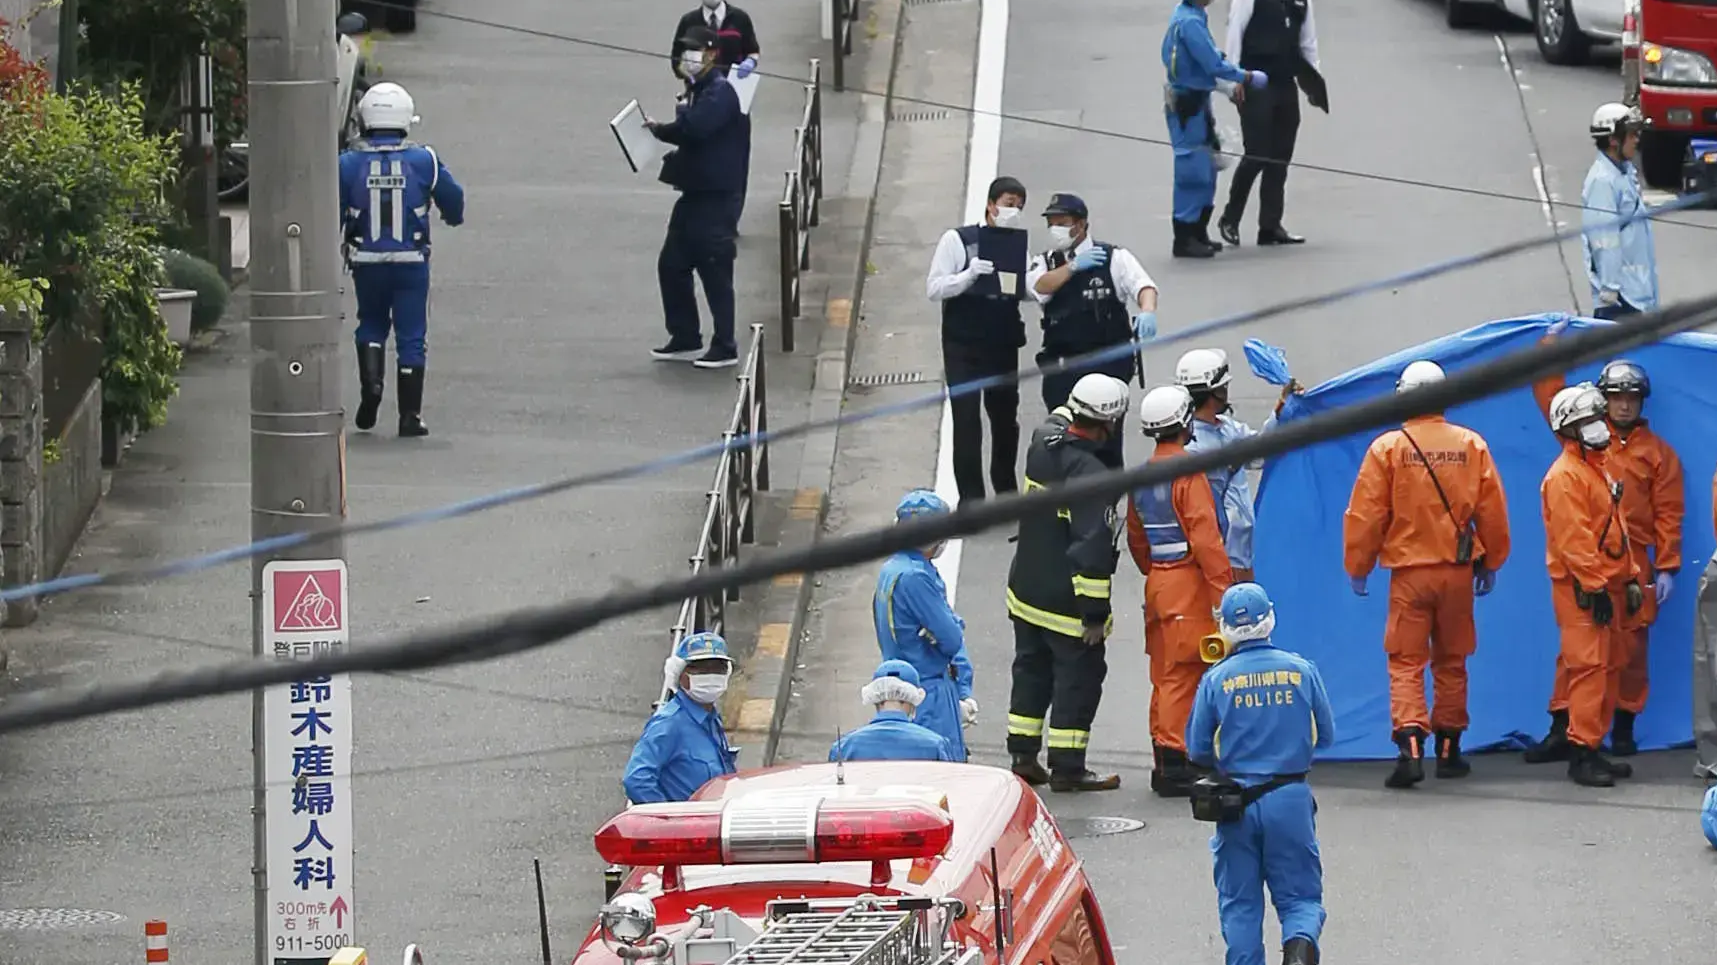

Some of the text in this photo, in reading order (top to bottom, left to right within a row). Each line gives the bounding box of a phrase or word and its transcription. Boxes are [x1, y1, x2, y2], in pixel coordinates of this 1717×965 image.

[1234, 690, 1293, 709] POLICE
[290, 671, 336, 890] 鈴木産婦人科
[276, 901, 327, 916] 300m先
[275, 933, 349, 952] 911-5000
